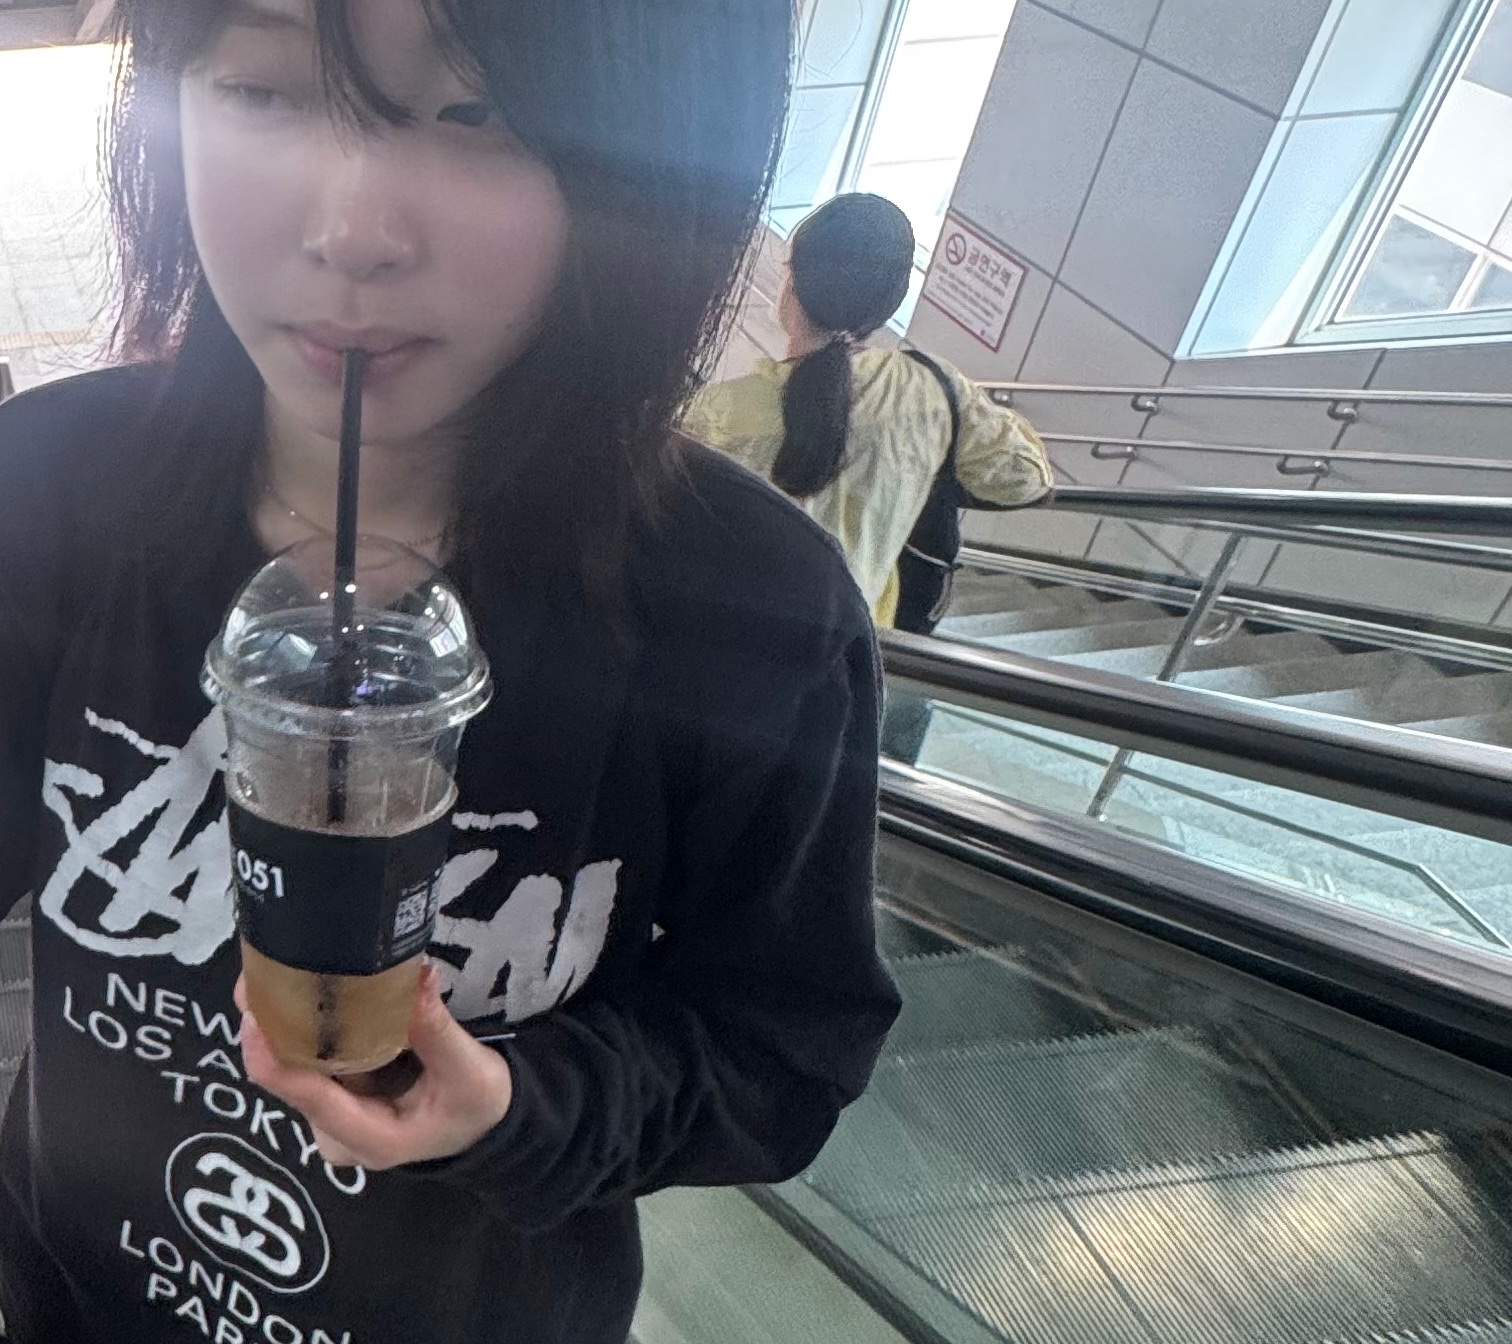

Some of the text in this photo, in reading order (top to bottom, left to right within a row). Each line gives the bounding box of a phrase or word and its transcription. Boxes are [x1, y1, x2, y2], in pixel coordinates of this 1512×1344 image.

[237, 849, 285, 899] 051
[63, 985, 173, 1061] LOS
[106, 972, 241, 1046] NEW
